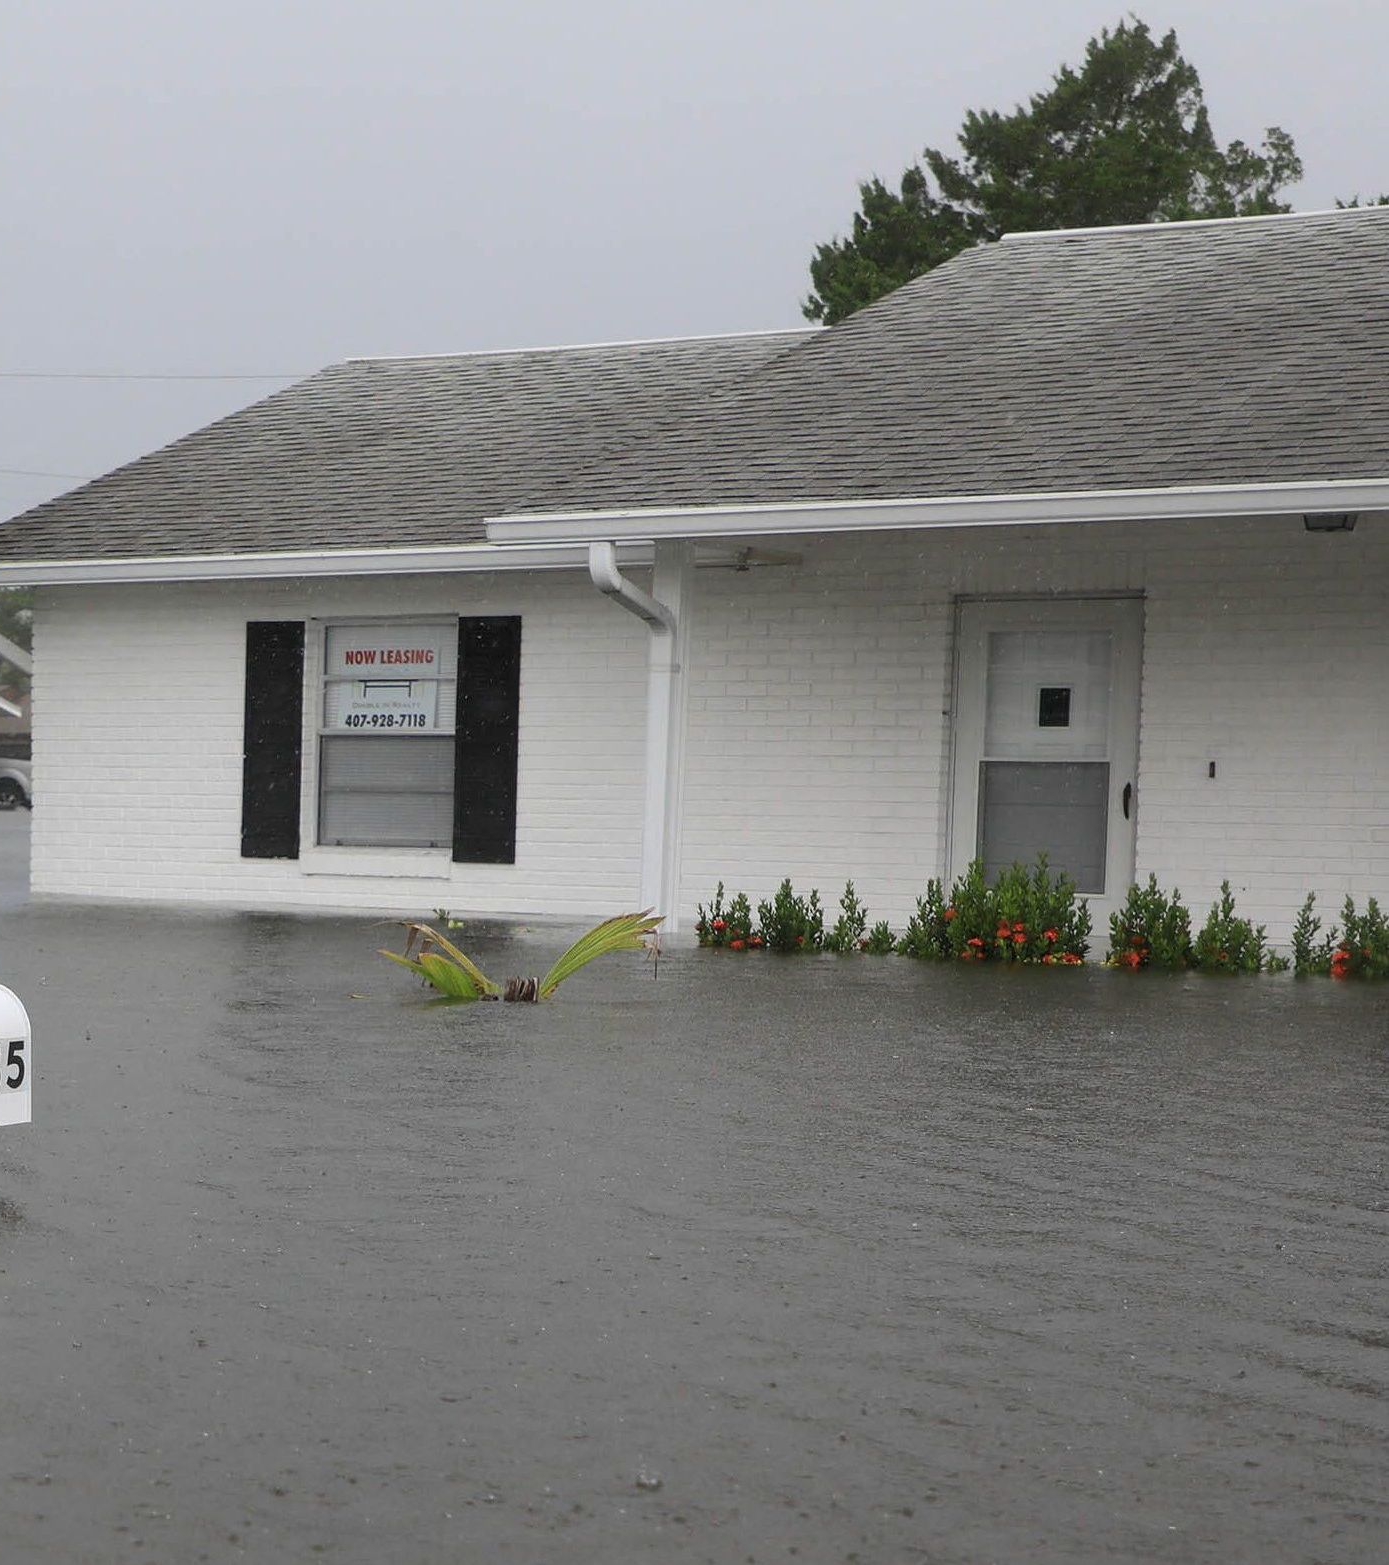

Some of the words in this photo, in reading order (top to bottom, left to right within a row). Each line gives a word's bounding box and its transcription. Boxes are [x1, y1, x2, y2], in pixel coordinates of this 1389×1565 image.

[345, 650, 376, 665] NOW
[380, 649, 434, 664] LEASING
[345, 713, 426, 728] 407-928-7118
